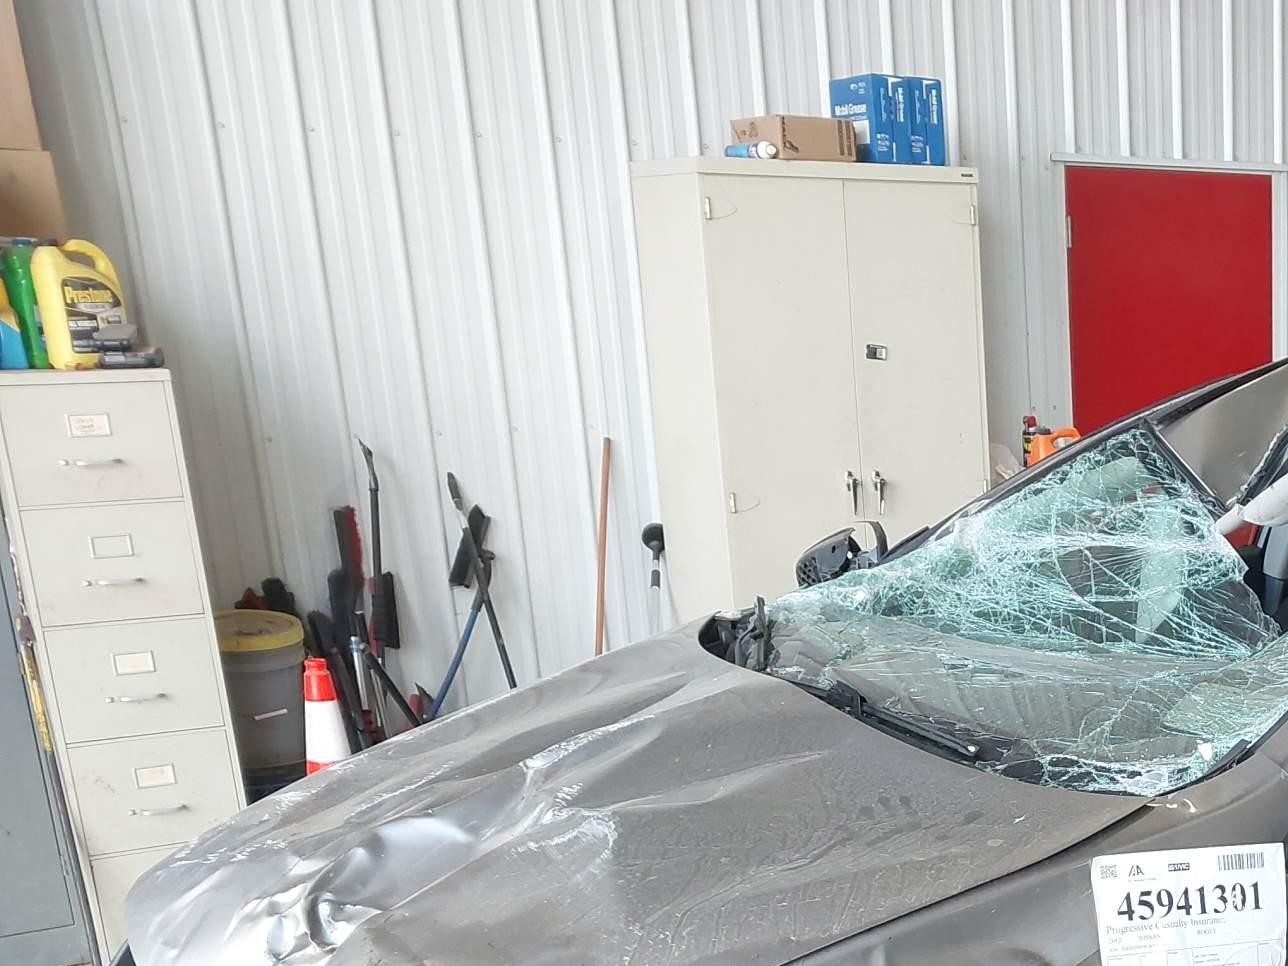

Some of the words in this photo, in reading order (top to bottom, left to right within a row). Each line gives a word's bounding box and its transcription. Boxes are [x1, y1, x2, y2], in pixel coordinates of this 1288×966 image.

[1117, 881, 1263, 921] 45941301
[1106, 923, 1153, 936] Progressive
[1190, 916, 1226, 926] Insuranc
